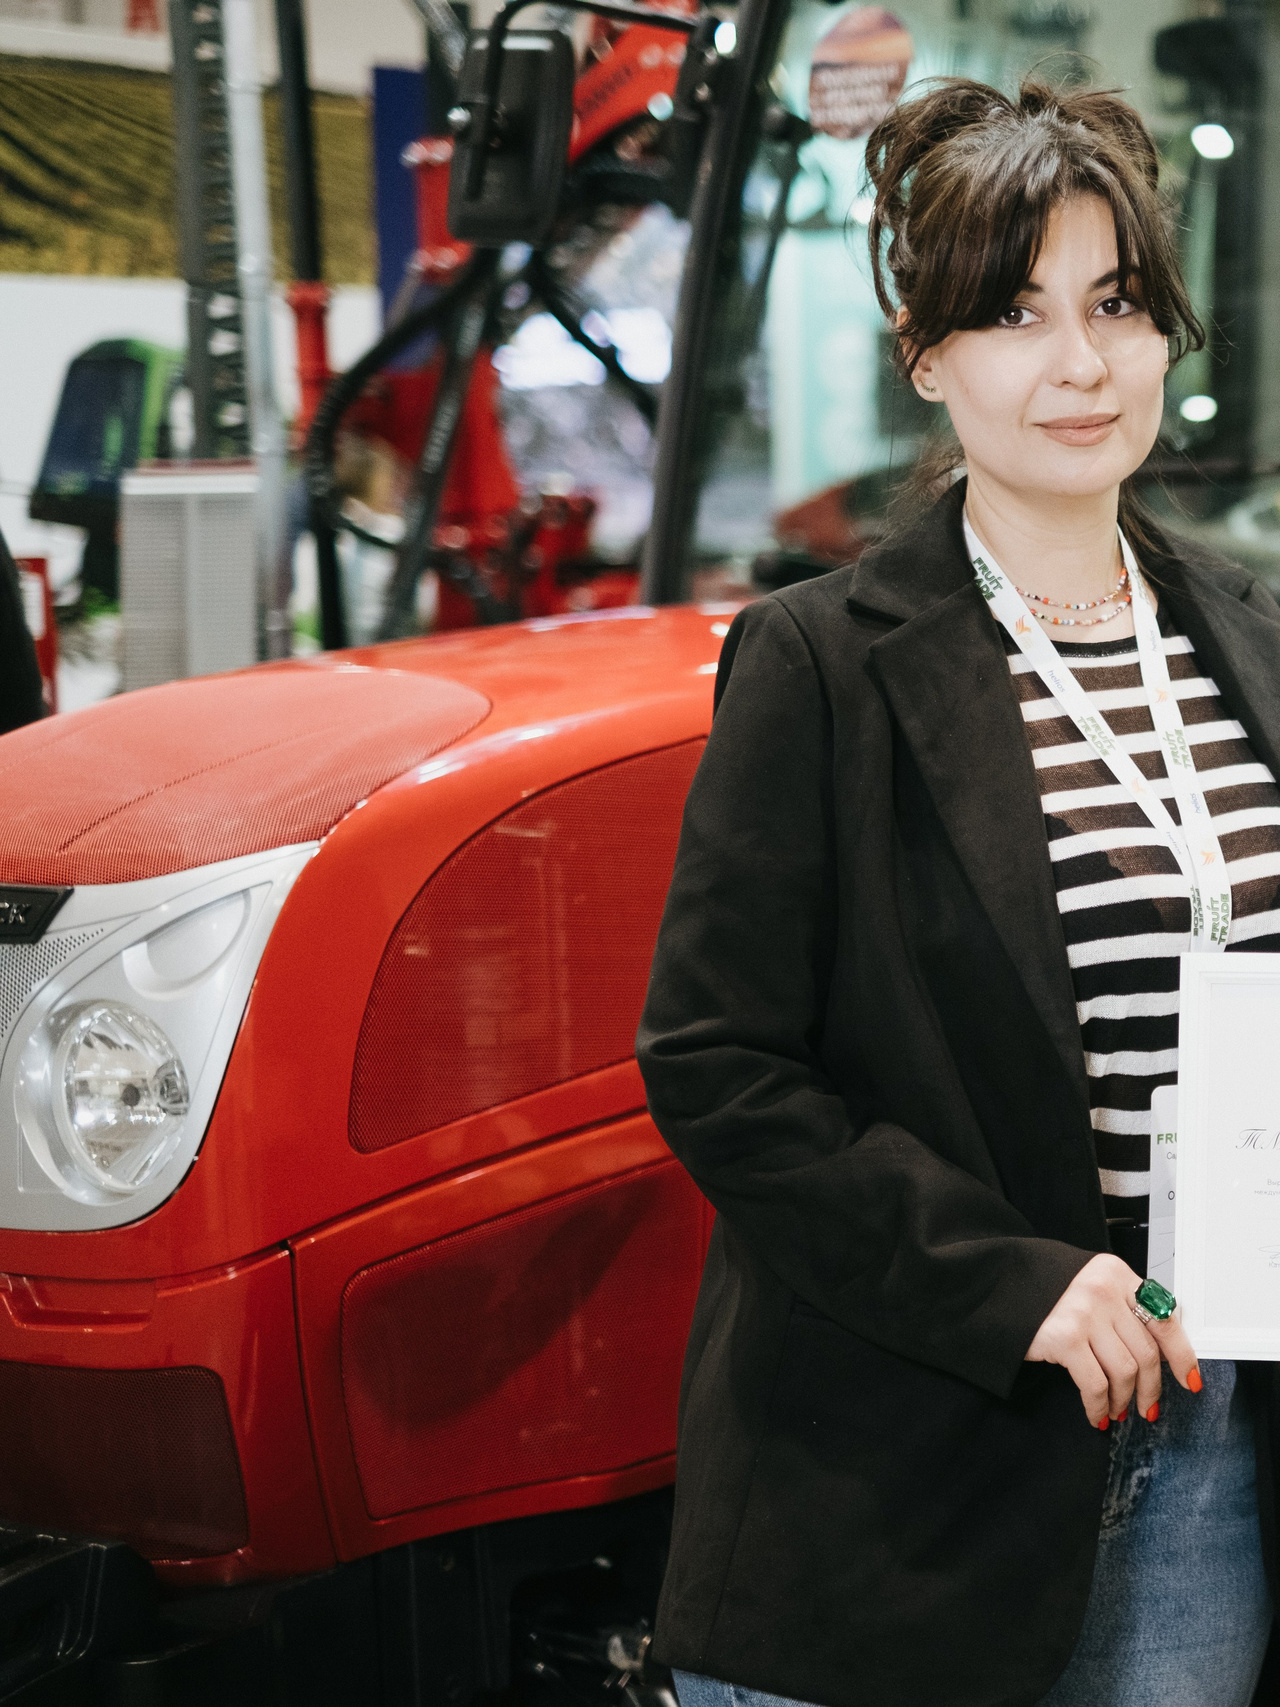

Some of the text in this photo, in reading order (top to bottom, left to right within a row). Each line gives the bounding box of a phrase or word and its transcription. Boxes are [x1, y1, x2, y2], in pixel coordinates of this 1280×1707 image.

[1047, 669, 1066, 693] helios
[1077, 715, 1111, 757] TRADE
[1174, 728, 1193, 769] TRADE
[1217, 893, 1230, 946] TRADE
